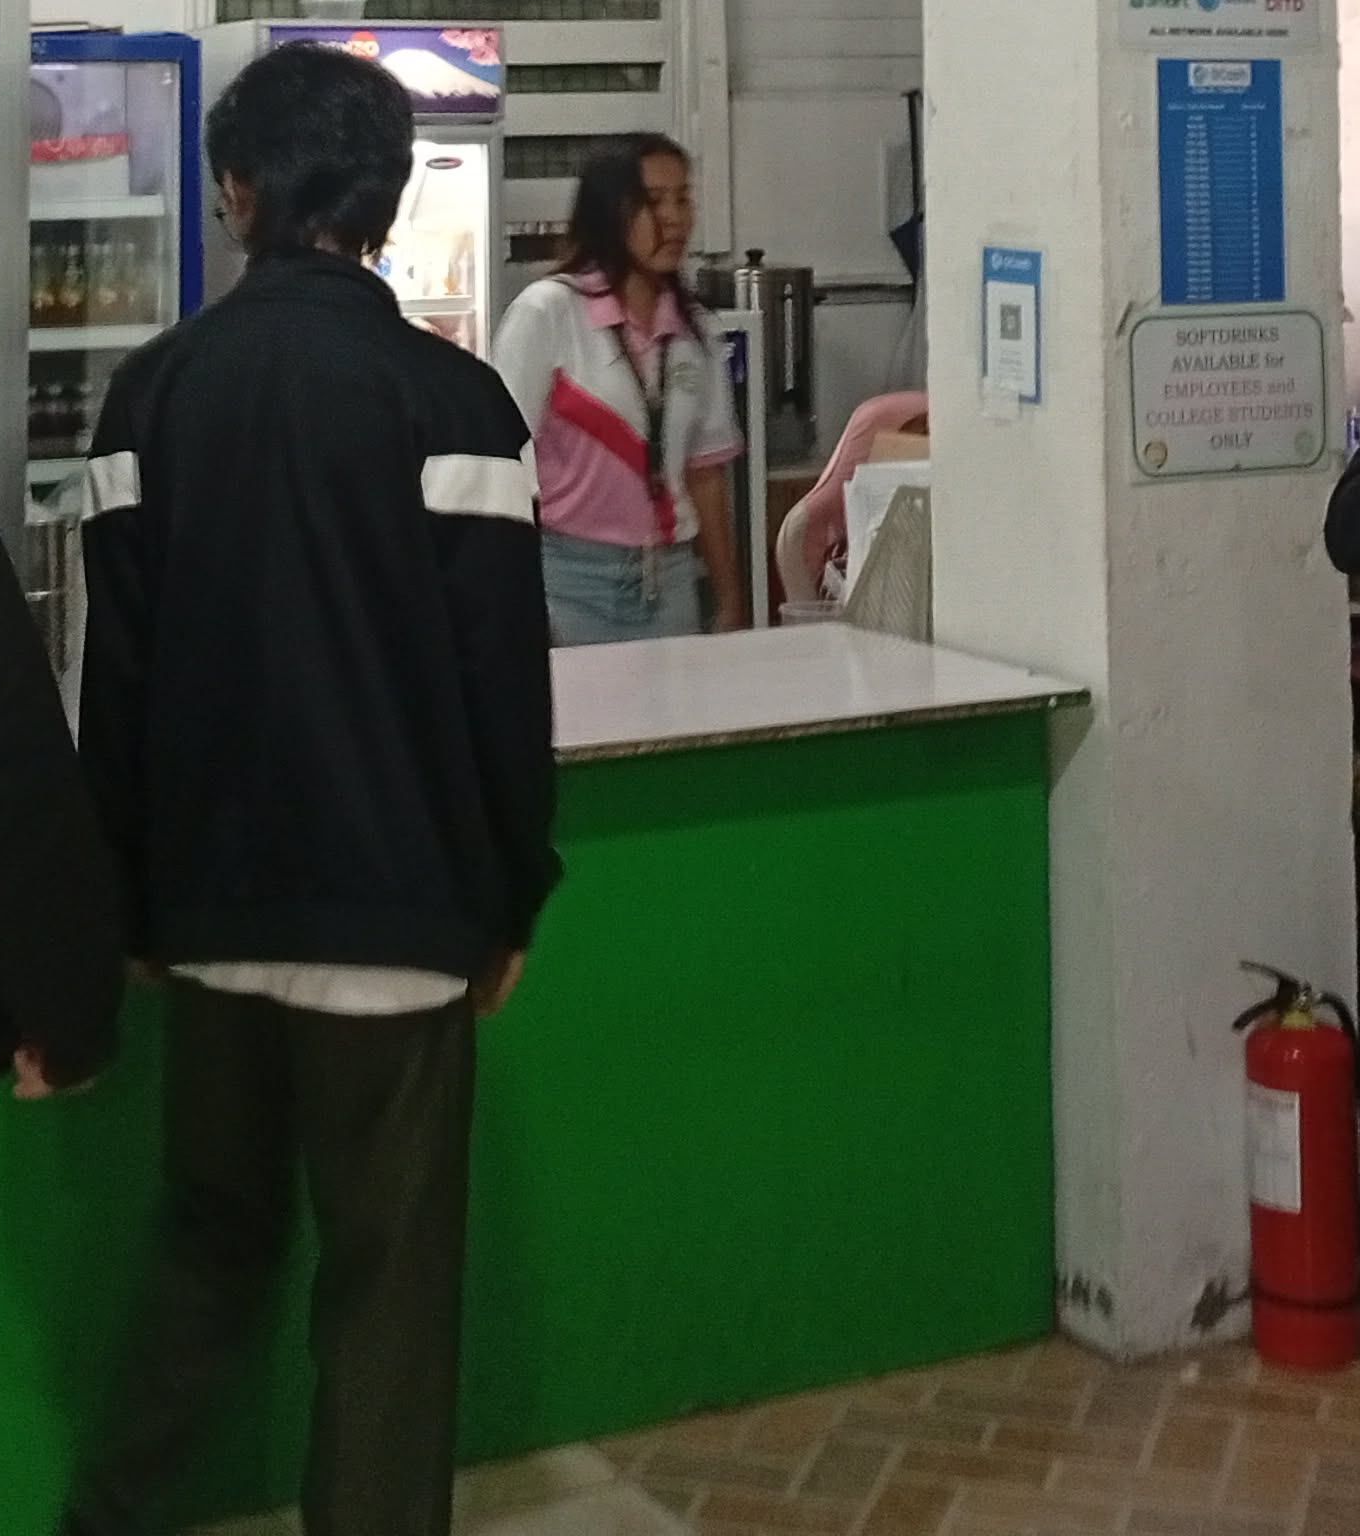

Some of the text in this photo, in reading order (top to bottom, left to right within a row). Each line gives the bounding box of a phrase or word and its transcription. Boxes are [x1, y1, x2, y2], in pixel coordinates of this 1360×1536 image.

[1175, 327, 1280, 347] SOFTDRINKS
[1171, 353, 1260, 373] AVAILABLE
[1163, 379, 1263, 400] EMPLOYEES
[1145, 402, 1314, 428] COLLEGE STUDENTS
[1209, 431, 1254, 451] ONLY
